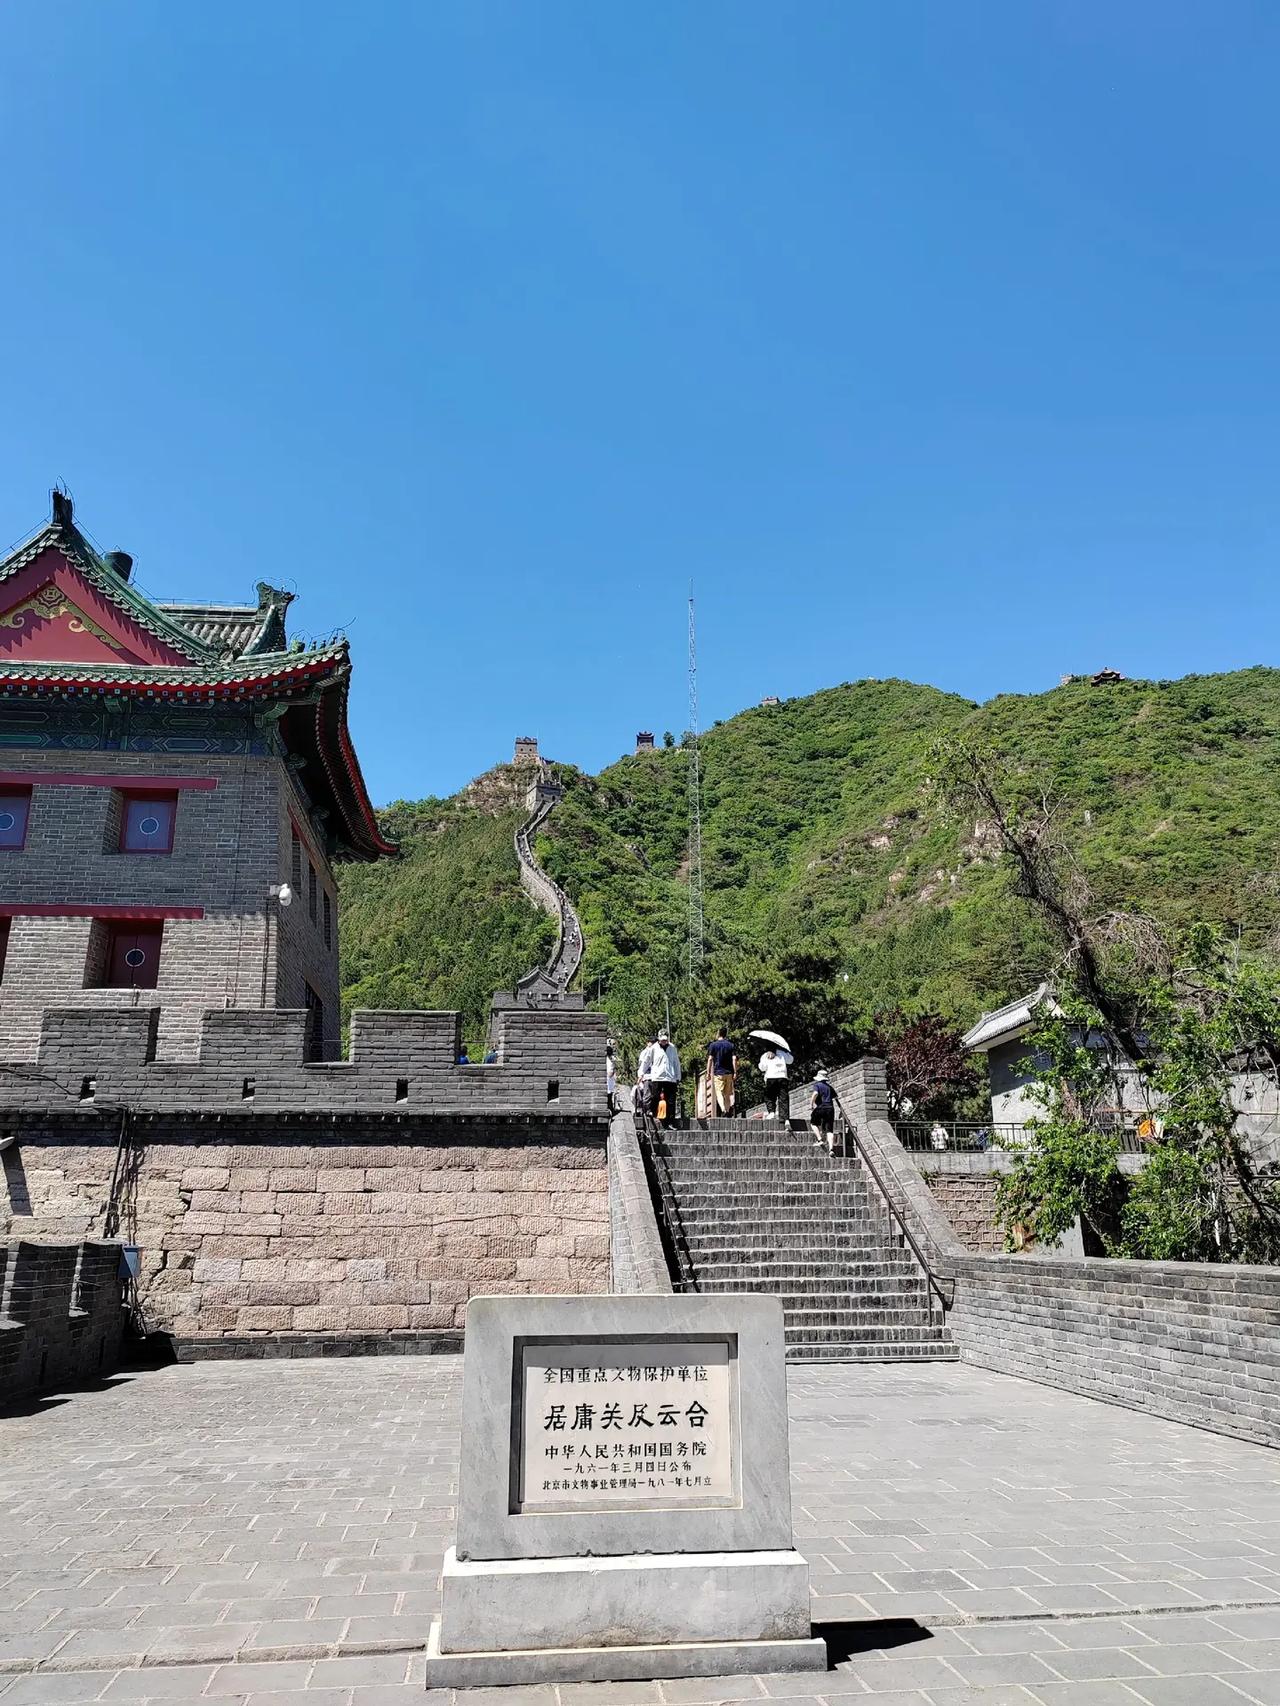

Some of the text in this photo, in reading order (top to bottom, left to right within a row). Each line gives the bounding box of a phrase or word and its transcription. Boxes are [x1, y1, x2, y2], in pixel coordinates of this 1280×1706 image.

[543, 1366, 708, 1383] 全国重点文物保护单位
[543, 1400, 709, 1431] 居庸关及云台
[544, 1441, 707, 1459] 中华人民共和国国务院
[563, 1460, 692, 1474] 一九六一年三月四日公布
